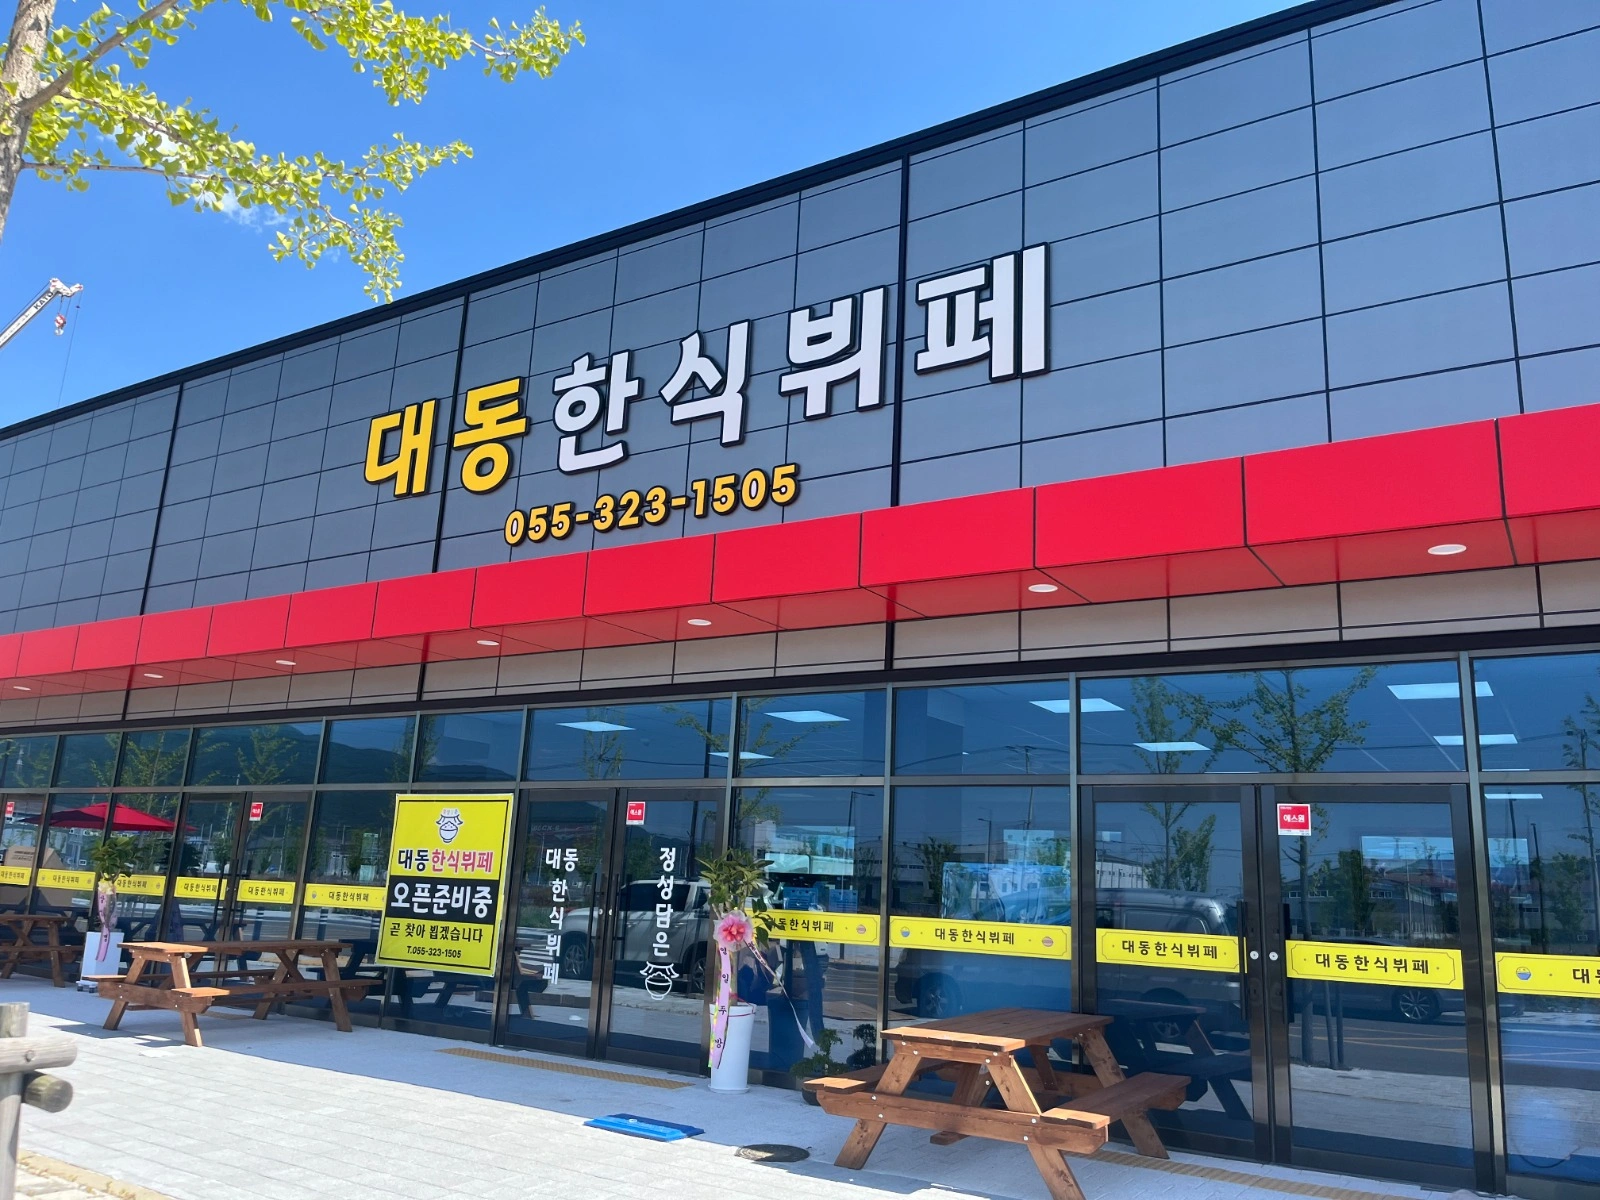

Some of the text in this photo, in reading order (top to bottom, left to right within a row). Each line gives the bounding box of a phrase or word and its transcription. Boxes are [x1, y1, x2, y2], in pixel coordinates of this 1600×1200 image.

[33, 291, 54, 310] KATO
[504, 463, 799, 547] 055-323-1505
[1283, 814, 1305, 822] 에스원
[545, 848, 579, 872] 대동
[248, 887, 285, 897] 대동한식뷔페
[329, 892, 369, 902] 대동한식뷔페
[391, 883, 493, 918] 오픈준비중
[652, 847, 676, 957] 정성담은
[390, 923, 483, 942] 곧 찾아 뵙겠습니다
[542, 878, 568, 985] 한식뷔페
[773, 918, 834, 933] 동한식뷔페
[935, 928, 1015, 945] 대동한식뷔페
[406, 946, 461, 958] T.055-323-1505
[1122, 939, 1218, 960] 대동한식뷔페
[1315, 953, 1429, 976] 대동한식뷔페
